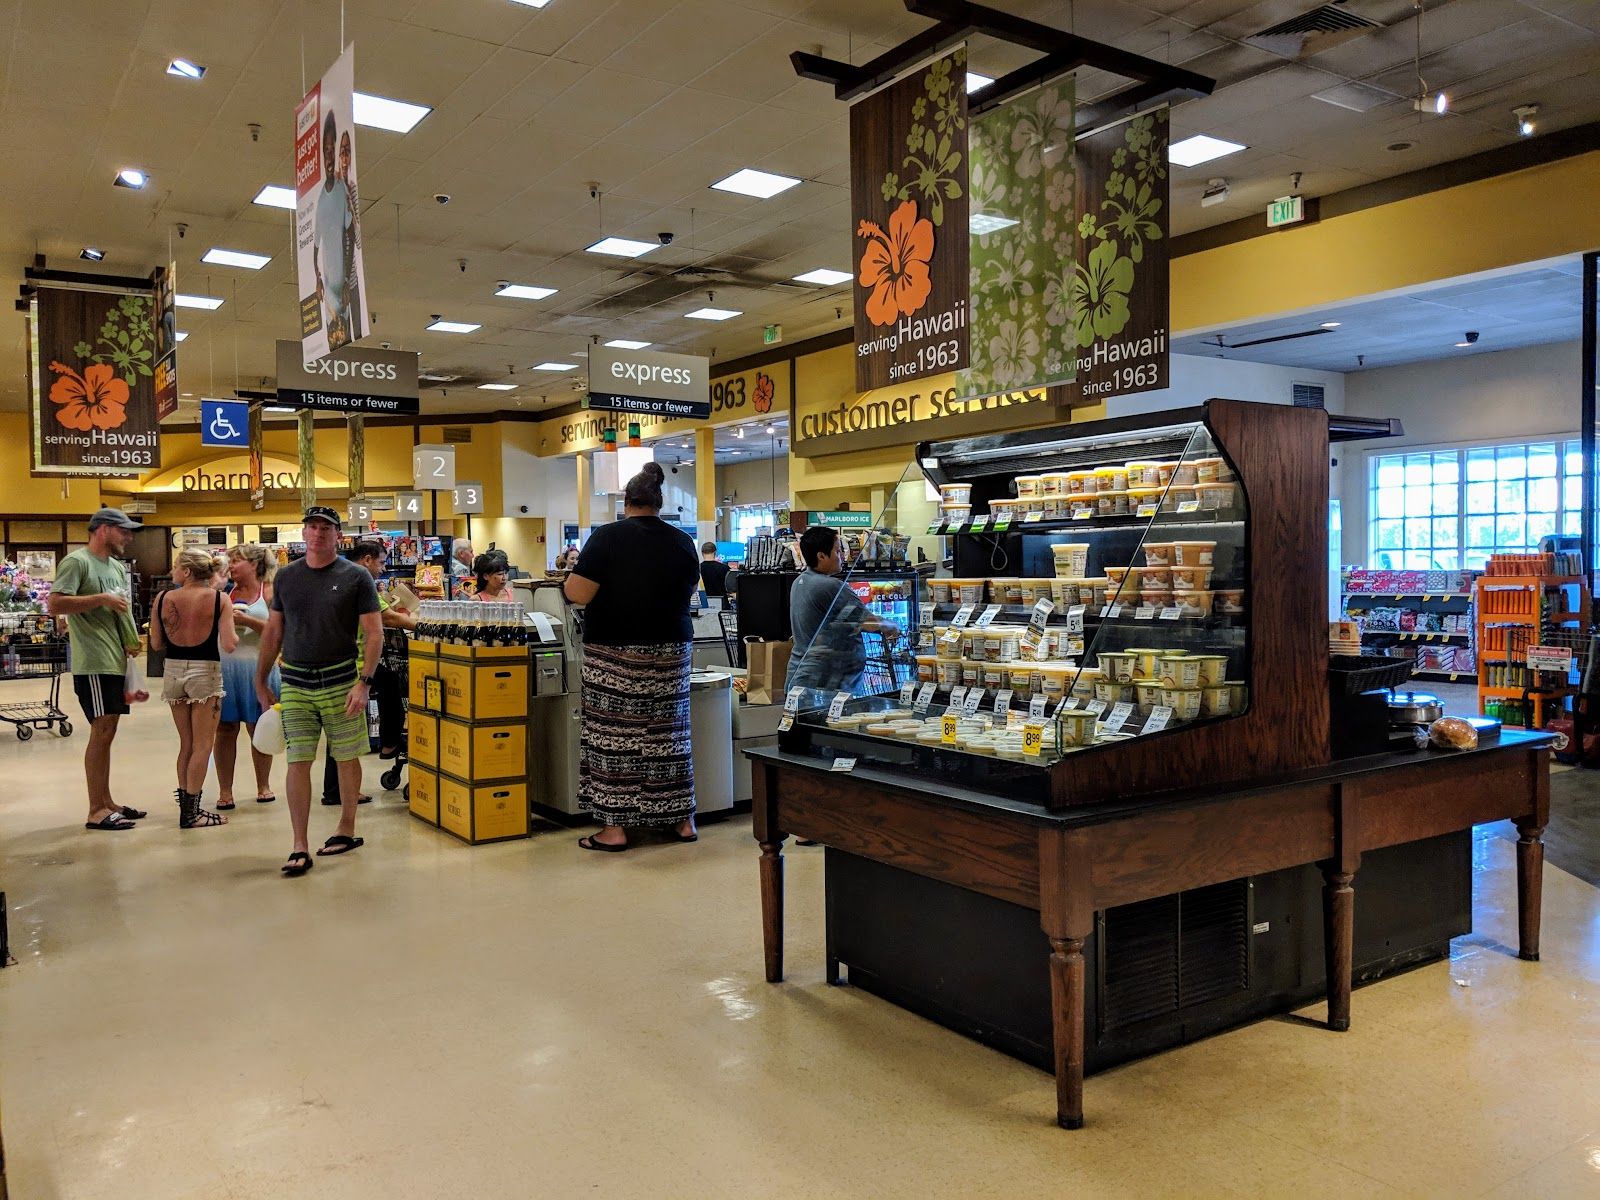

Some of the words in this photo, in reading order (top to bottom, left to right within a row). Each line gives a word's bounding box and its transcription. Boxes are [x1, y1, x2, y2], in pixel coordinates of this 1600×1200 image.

[1273, 200, 1295, 224] EXIT
[858, 335, 897, 357] serving
[899, 300, 965, 345] Hawaii
[889, 362, 917, 379] since
[917, 340, 959, 372] 1963
[1050, 356, 1092, 374] serving
[1094, 329, 1165, 366] Hawaii
[303, 359, 397, 381] express
[611, 361, 691, 385] express
[1082, 381, 1112, 396] since
[1112, 363, 1158, 390] 1963
[301, 393, 315, 404] 15
[317, 394, 347, 406] items
[350, 399, 362, 407] or
[366, 396, 399, 409] fewer
[610, 397, 621, 407] 15
[623, 398, 650, 410] items
[652, 402, 662, 411] or
[665, 401, 693, 413] fewer
[709, 377, 746, 413] 1963
[801, 394, 920, 440] customer
[45, 434, 90, 448] serving
[92, 429, 157, 447] Hawaii
[561, 414, 606, 443] serving
[81, 452, 111, 464] since
[111, 449, 152, 465] 1963
[416, 457, 422, 478] 2
[433, 456, 445, 477] 2
[407, 499, 418, 513] 4
[466, 489, 477, 504] 3
[359, 506, 367, 519] 5
